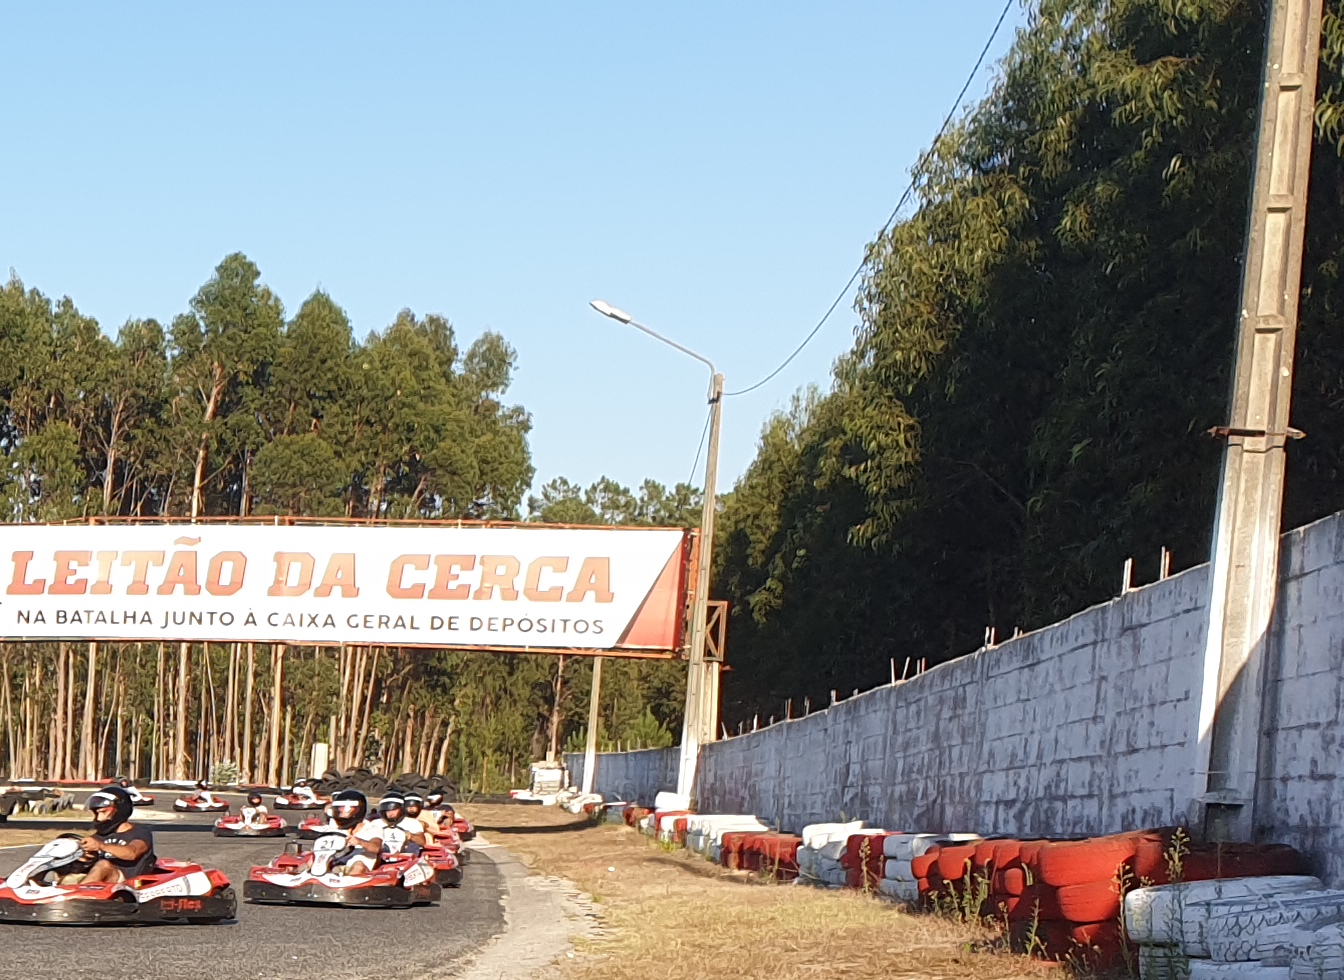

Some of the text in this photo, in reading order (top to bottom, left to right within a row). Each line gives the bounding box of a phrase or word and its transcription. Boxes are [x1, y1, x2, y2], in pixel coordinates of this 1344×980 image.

[5, 535, 615, 604] LEITÃO DA CERCA
[16, 609, 47, 625] NA
[55, 609, 154, 626] BATALHA
[160, 610, 235, 630] JUNTO
[266, 611, 337, 630] CAIXA
[346, 613, 421, 631] GERAL
[429, 615, 460, 632] DE
[469, 613, 605, 635] DEPÓSITOS
[320, 840, 335, 850] 21
